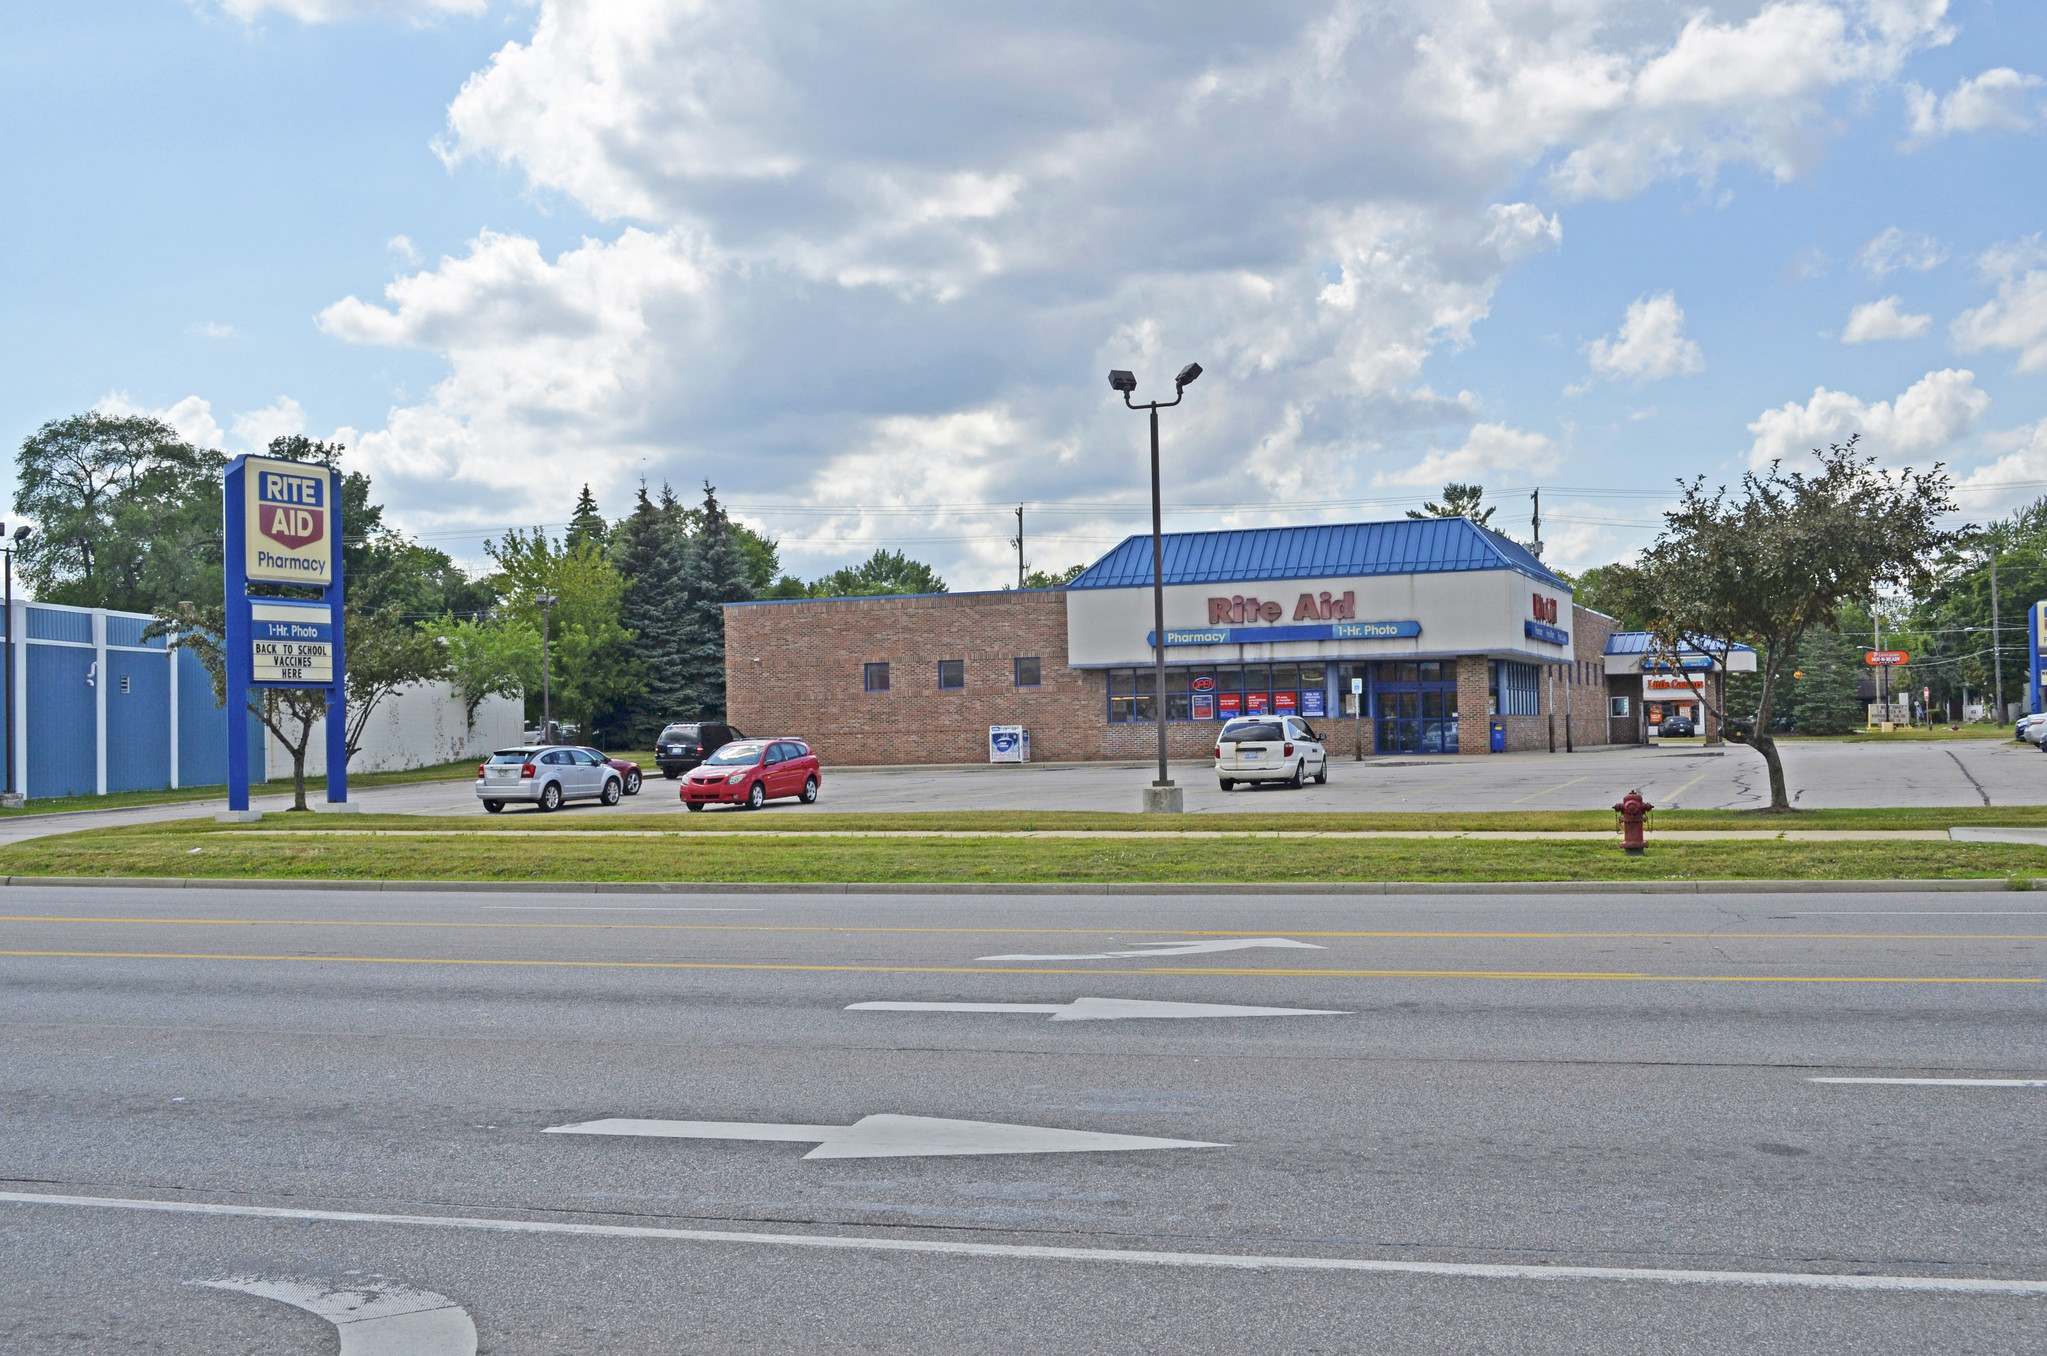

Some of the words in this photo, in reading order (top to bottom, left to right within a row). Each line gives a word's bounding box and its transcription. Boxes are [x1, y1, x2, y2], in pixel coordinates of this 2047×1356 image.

[267, 474, 316, 504] RITE
[271, 508, 314, 537] AID
[258, 551, 326, 575] Pharmacy
[1208, 595, 1282, 624] Rite
[1293, 591, 1355, 620] Aid
[268, 624, 289, 636] 1-Hr.
[292, 625, 318, 637] Photo
[1338, 626, 1361, 636] 1-Hr.
[1364, 625, 1398, 635] Photo
[1168, 633, 1226, 643] Pharmacy
[256, 644, 277, 654] BACK
[283, 645, 293, 654] TO
[298, 645, 327, 656] SCHOOL
[274, 656, 312, 667] VACCINES
[282, 669, 302, 679] HERE
[1192, 679, 1215, 689] OPEN
[1648, 679, 1671, 690] Little
